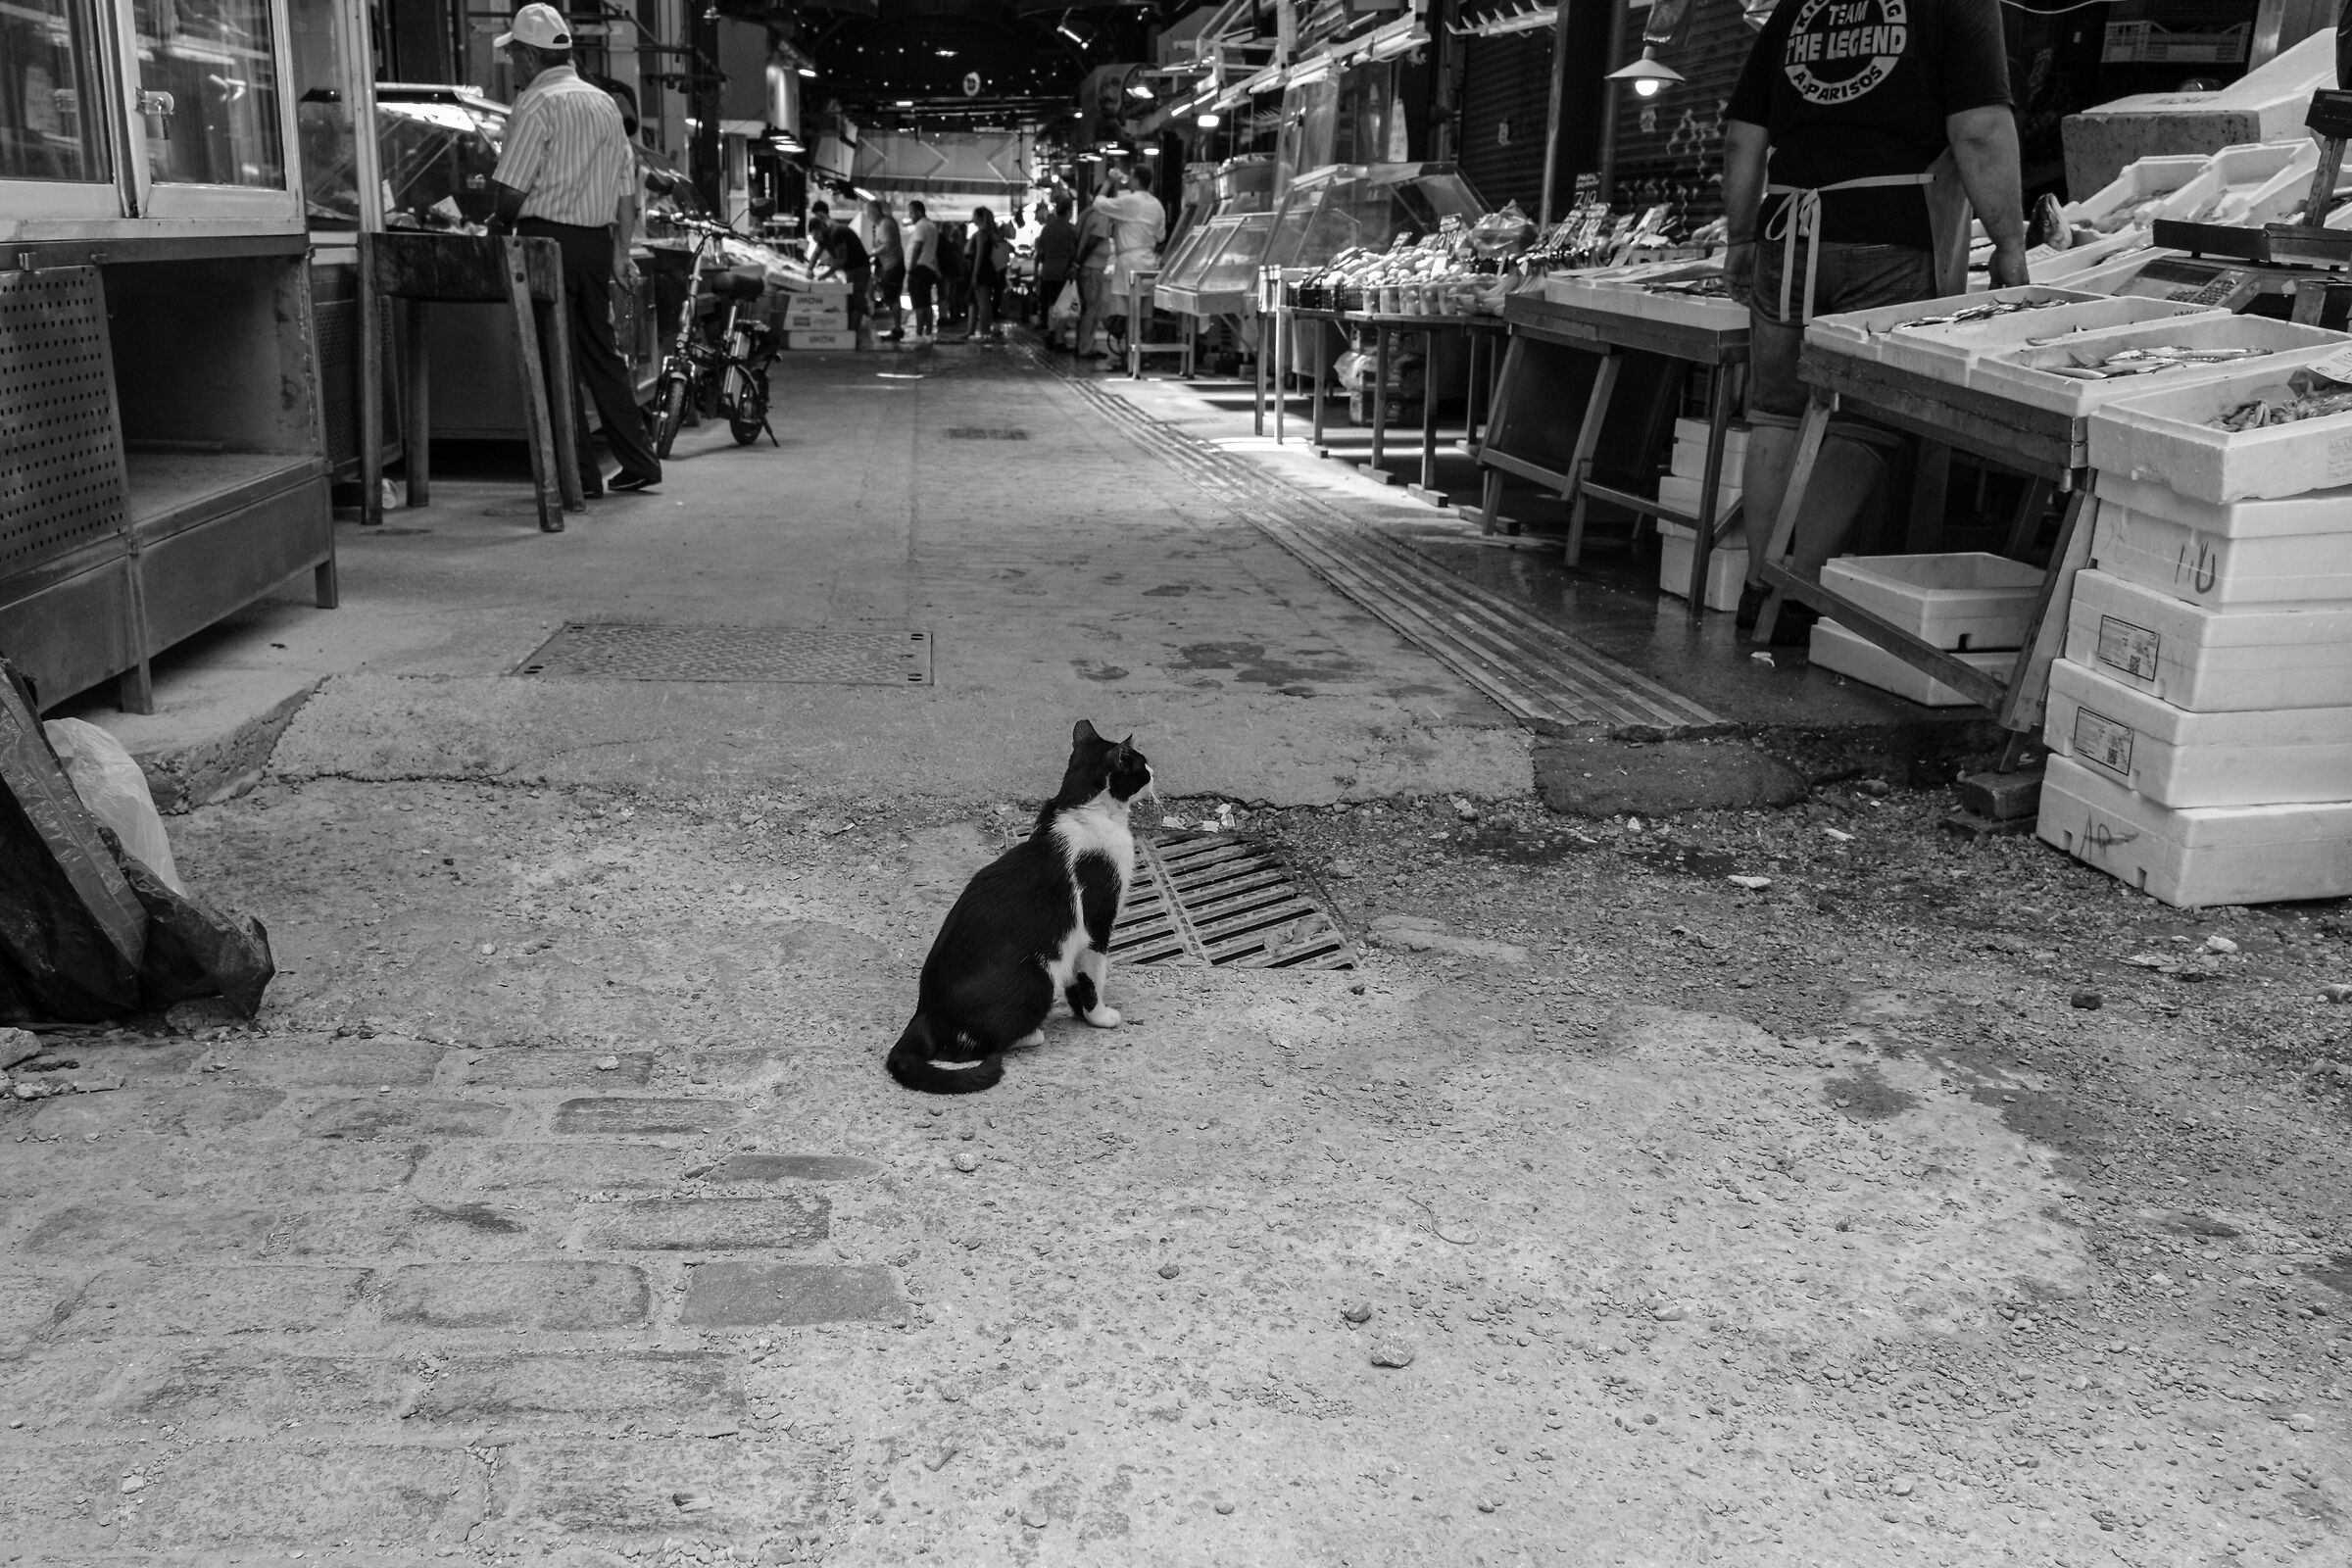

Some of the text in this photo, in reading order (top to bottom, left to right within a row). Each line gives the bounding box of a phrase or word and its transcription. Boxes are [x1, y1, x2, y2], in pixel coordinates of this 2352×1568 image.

[1829, 1, 1869, 26] TEAM
[1785, 25, 1907, 65] THE LEGEND
[1792, 65, 1884, 101] A.PARISOS
